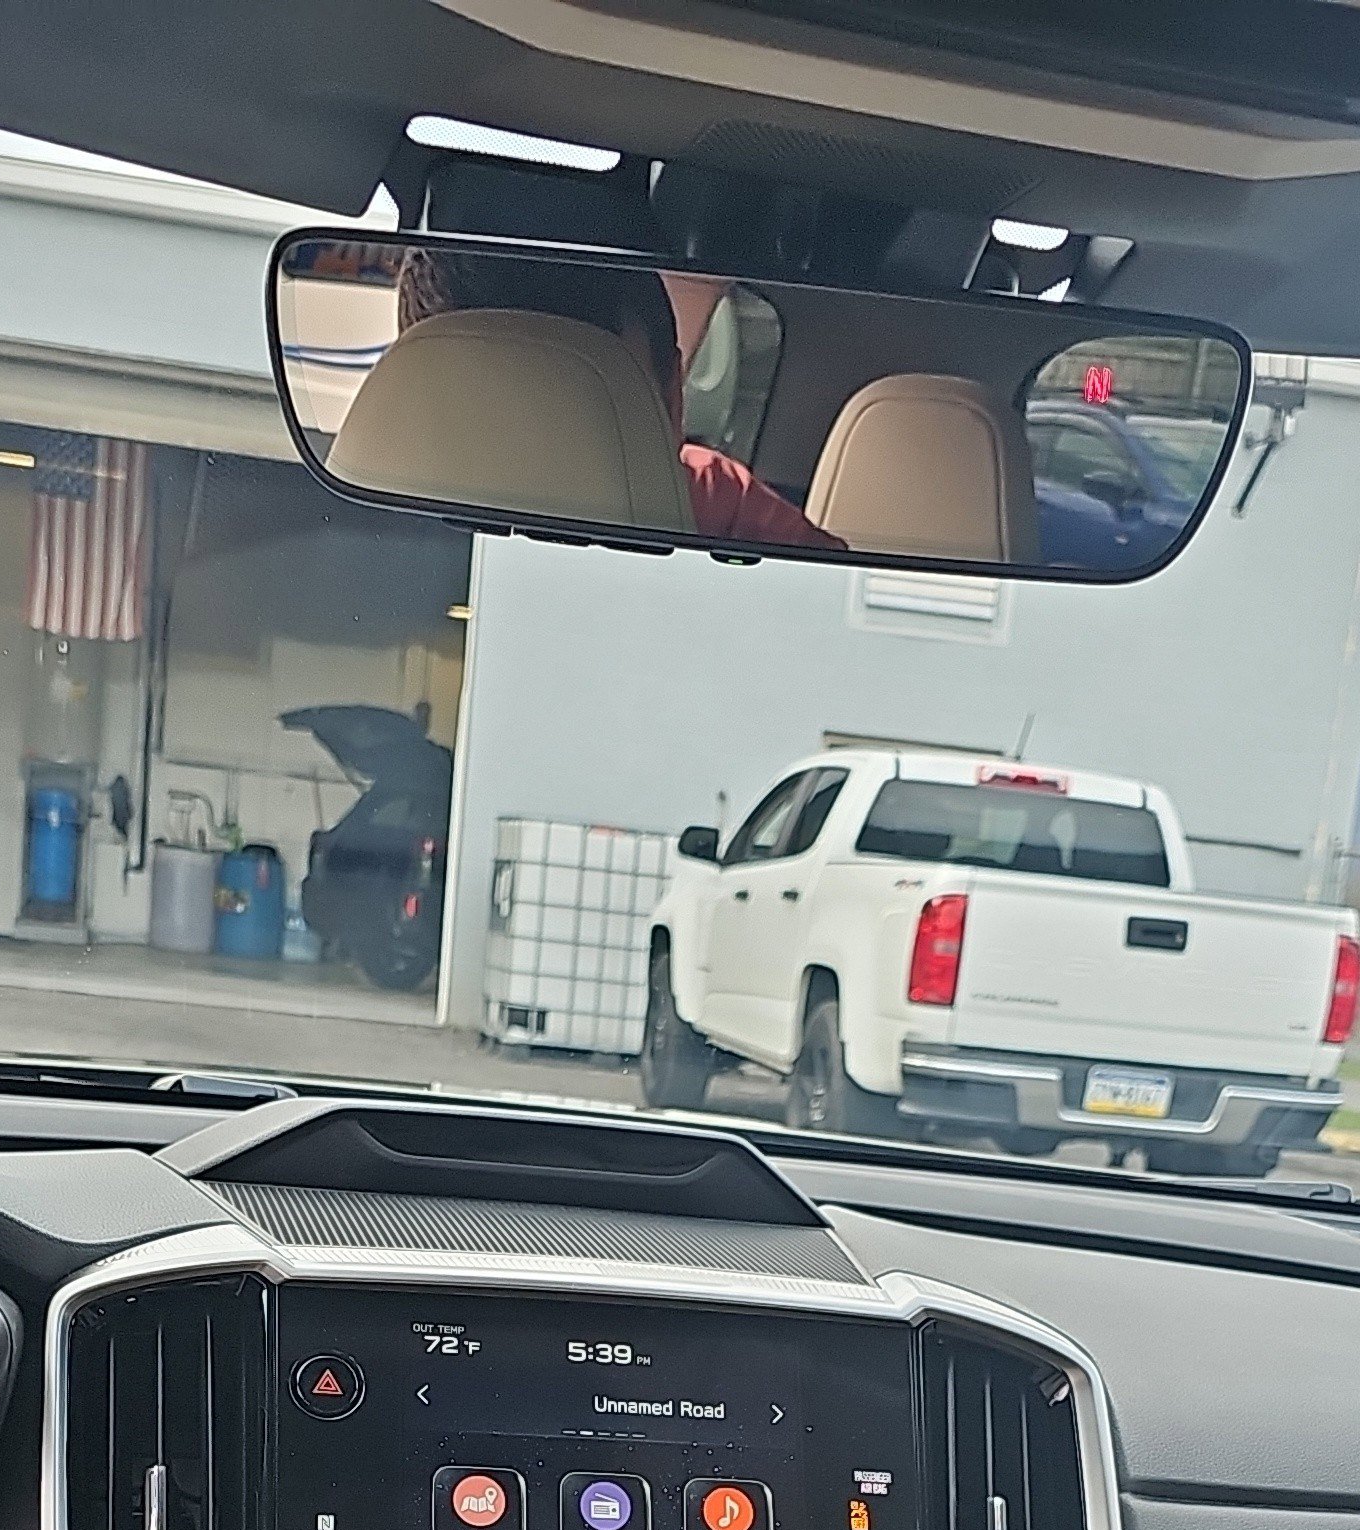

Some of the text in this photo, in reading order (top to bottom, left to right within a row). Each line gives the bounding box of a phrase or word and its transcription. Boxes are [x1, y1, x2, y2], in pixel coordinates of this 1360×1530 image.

[1085, 366, 1111, 403] N
[413, 1323, 464, 1335] OUT TEMP
[424, 1335, 459, 1354] 72
[567, 1342, 651, 1365] 5:39 PM
[594, 1396, 725, 1419] Unnamed Road
